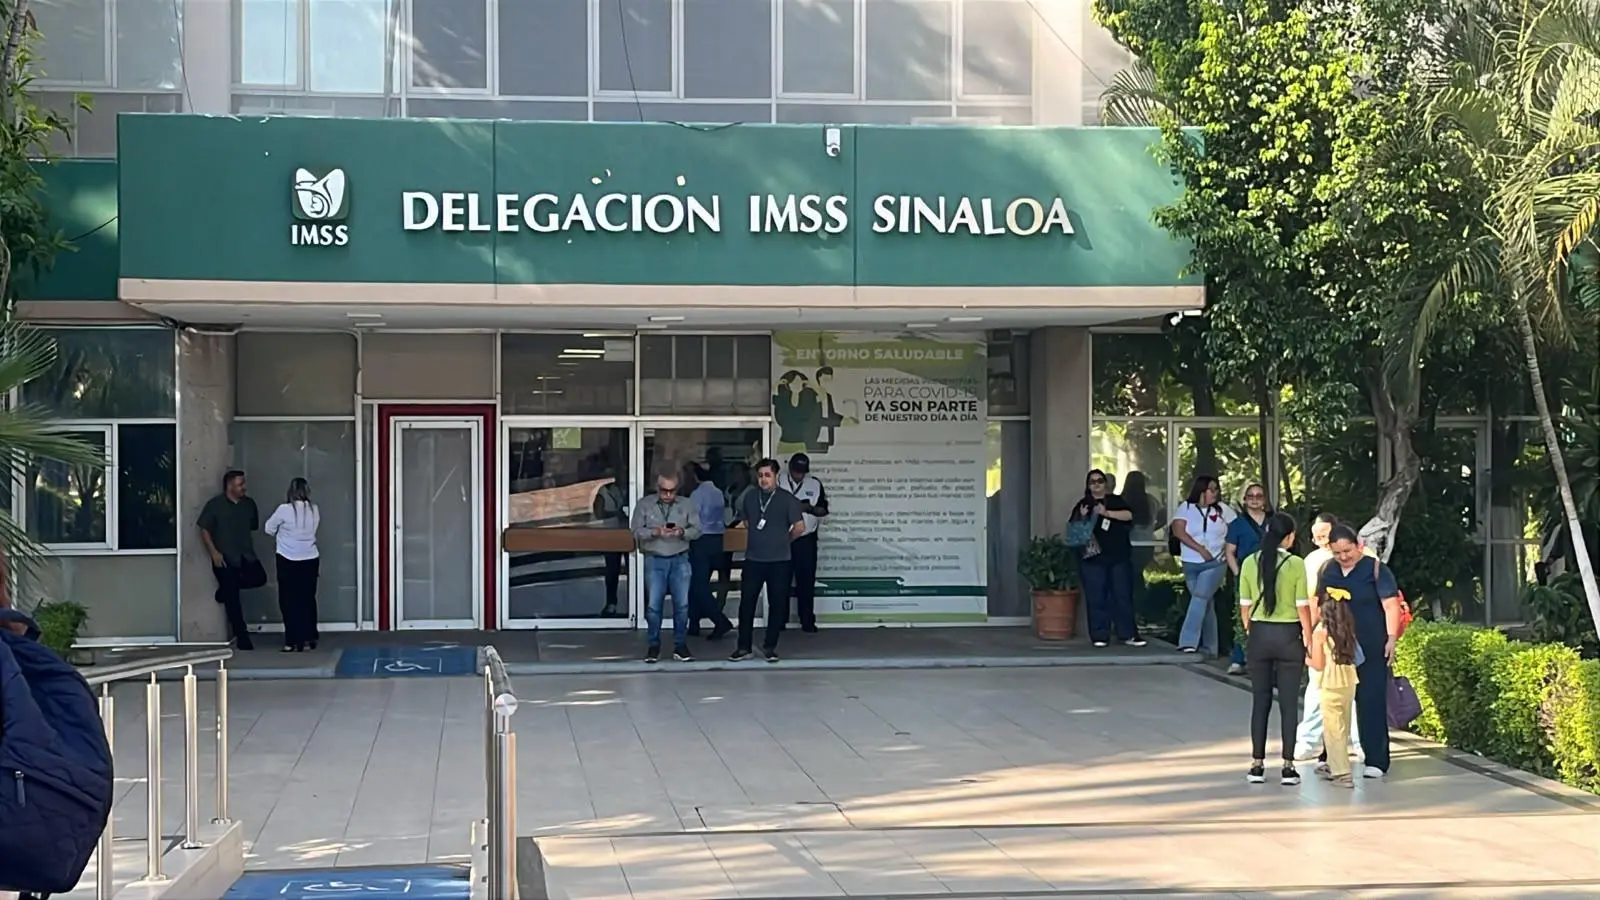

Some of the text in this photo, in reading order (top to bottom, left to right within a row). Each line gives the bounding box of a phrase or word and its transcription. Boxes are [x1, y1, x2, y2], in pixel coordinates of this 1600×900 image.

[402, 191, 1075, 236] DELEGACION IMSS SINALOA
[291, 224, 349, 246] IMSS
[874, 348, 964, 360] SALUDABLE
[864, 377, 880, 385] LAS
[863, 386, 977, 399] PARA COVID-19
[865, 400, 978, 412] YA SON PARTE
[864, 411, 978, 422] DE NUESTRO DÍA A DÍA
